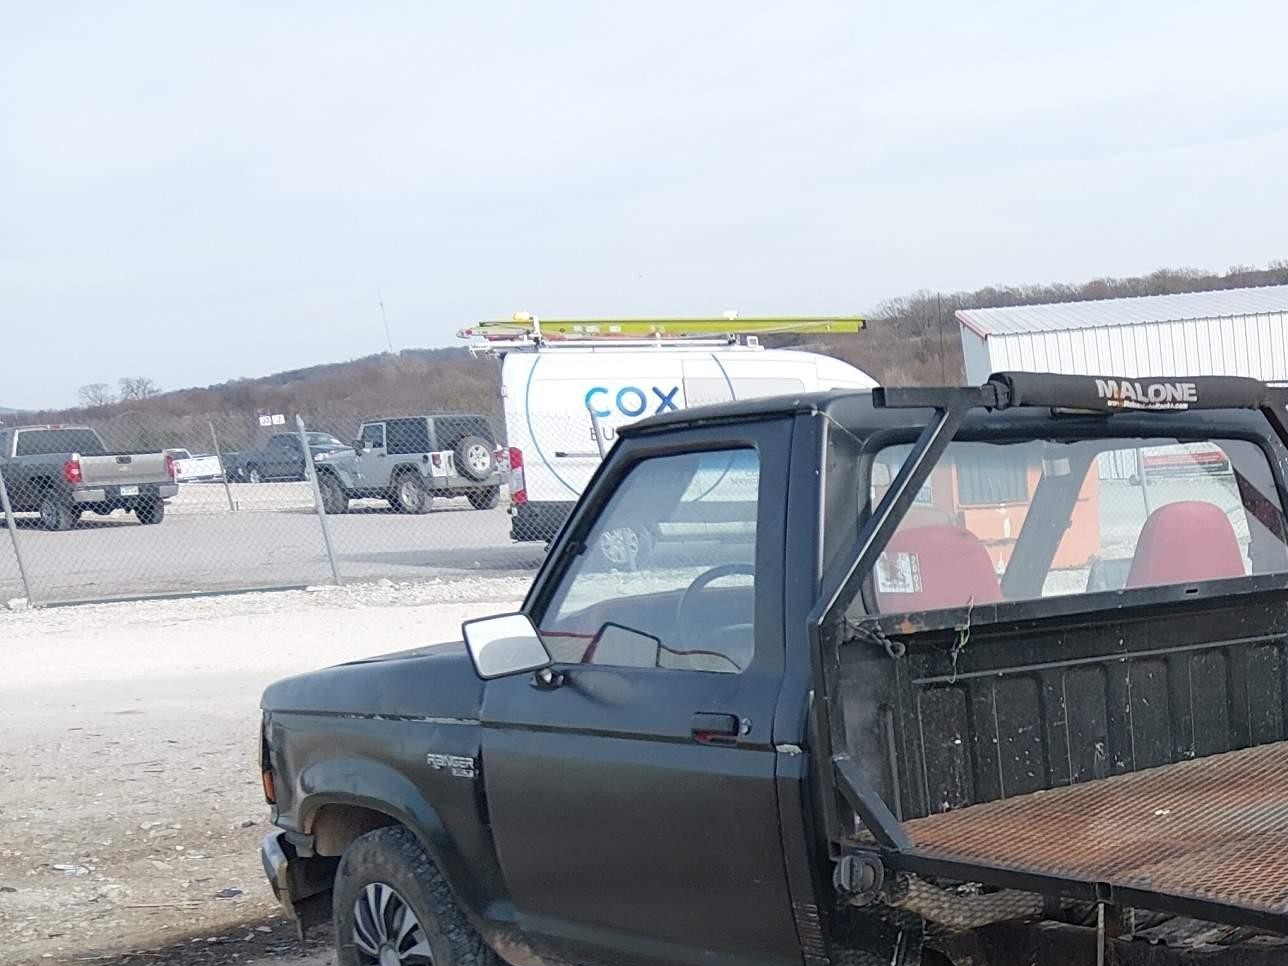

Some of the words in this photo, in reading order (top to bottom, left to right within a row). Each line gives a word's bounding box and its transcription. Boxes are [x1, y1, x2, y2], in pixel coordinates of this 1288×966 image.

[585, 386, 680, 417] COX
[1095, 379, 1198, 403] MALONE
[427, 753, 475, 770] RANGER
